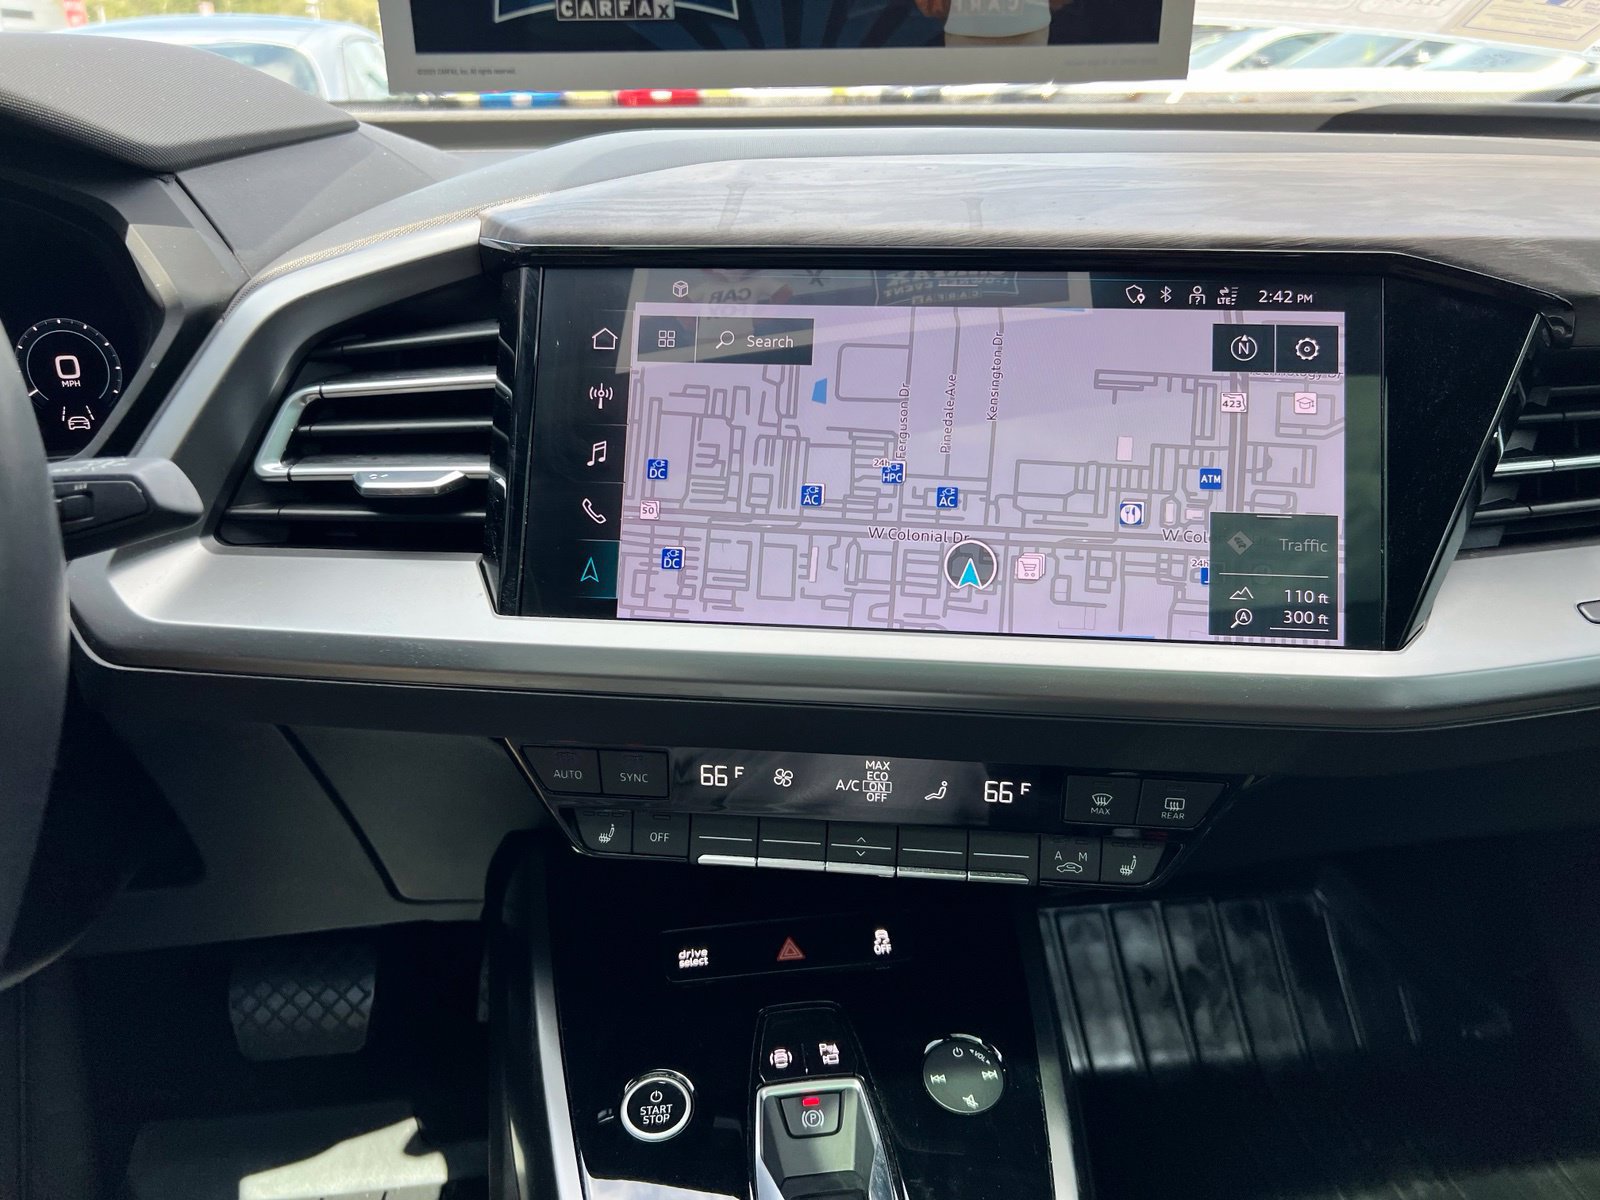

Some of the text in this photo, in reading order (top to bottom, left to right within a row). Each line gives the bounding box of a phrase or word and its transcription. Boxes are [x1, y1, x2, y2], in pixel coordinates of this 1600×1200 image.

[560, 0, 671, 19] CARFAX
[1259, 290, 1313, 303] 2:42 PM
[747, 335, 794, 348] Search
[55, 355, 80, 379] 0
[987, 331, 1003, 421] Kensington Dr
[61, 380, 81, 388] MPH
[1222, 400, 1242, 408] 423
[940, 374, 957, 453] Pinedale Ave
[896, 383, 910, 459] Ferguson Dr
[649, 469, 666, 478] DC
[883, 473, 902, 482] HPC
[1201, 474, 1221, 483] ATM
[803, 495, 819, 505] AC
[939, 497, 955, 507] AC
[868, 527, 969, 543] W Colonial Dr
[1162, 529, 1179, 541] W
[1280, 538, 1328, 552] Traffic
[663, 559, 681, 569] DC
[1191, 559, 1208, 567] 24h
[1285, 590, 1329, 604] 110 ft
[1283, 611, 1329, 625] 300 ft
[865, 760, 890, 770] MAX
[553, 770, 582, 780] AUTO
[619, 773, 648, 782] SYNC
[700, 764, 744, 786] 66 F
[866, 771, 888, 781] ECO
[835, 779, 860, 791] A/C
[869, 782, 886, 791] ON
[984, 781, 1031, 803] 66 F
[866, 793, 887, 802] OFF
[1091, 807, 1111, 815] MAX
[650, 832, 669, 842] OFF
[1054, 851, 1088, 861] A M
[679, 949, 708, 959] drive
[874, 944, 891, 955] OFF
[679, 957, 709, 968] select
[640, 1104, 672, 1115] START
[642, 1114, 670, 1124] STOP
